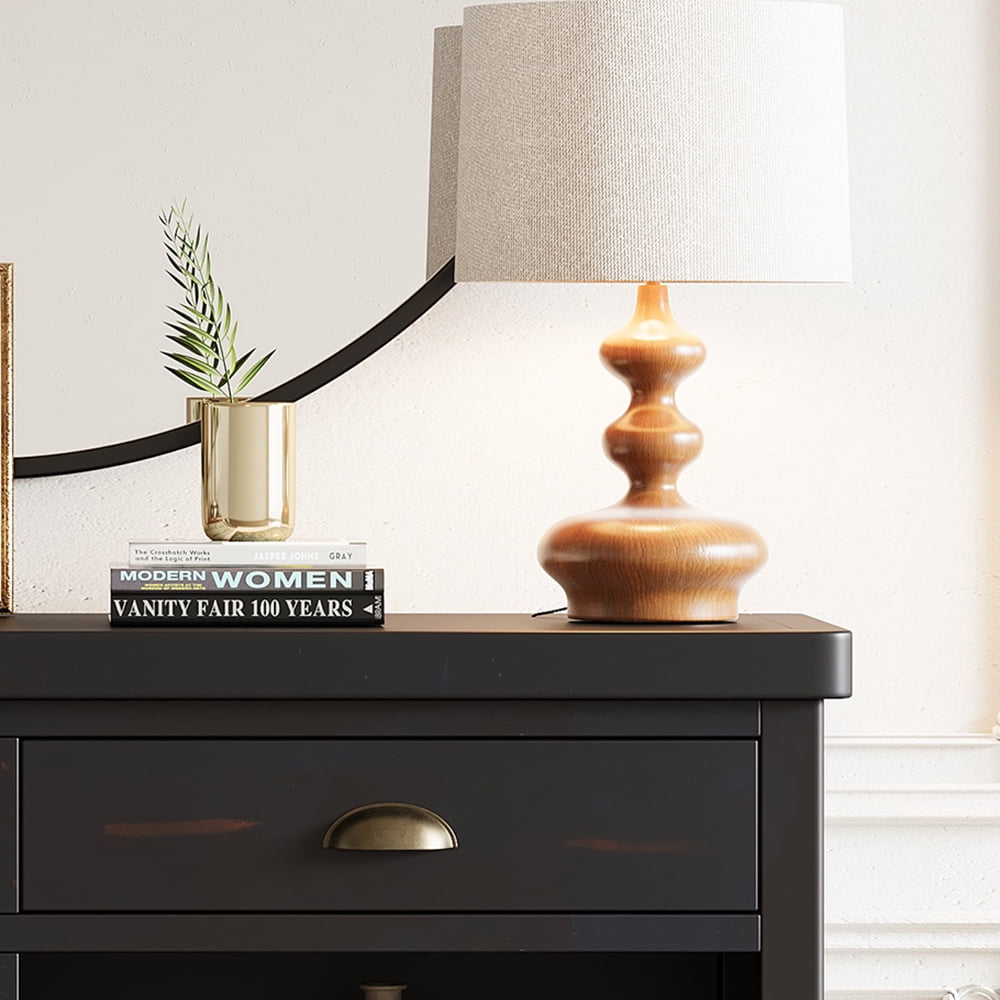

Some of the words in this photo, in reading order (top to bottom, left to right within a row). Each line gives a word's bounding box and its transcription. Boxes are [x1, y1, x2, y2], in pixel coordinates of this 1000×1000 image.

[254, 551, 287, 560] JASPER
[289, 551, 320, 560] JOHNS
[329, 552, 353, 560] GRAY
[120, 570, 206, 581] MODERN
[211, 570, 352, 589] WOMEN
[112, 599, 191, 617] VANITY
[197, 599, 245, 617] FAIR
[251, 599, 280, 617] 100
[285, 599, 353, 617] YEARS
